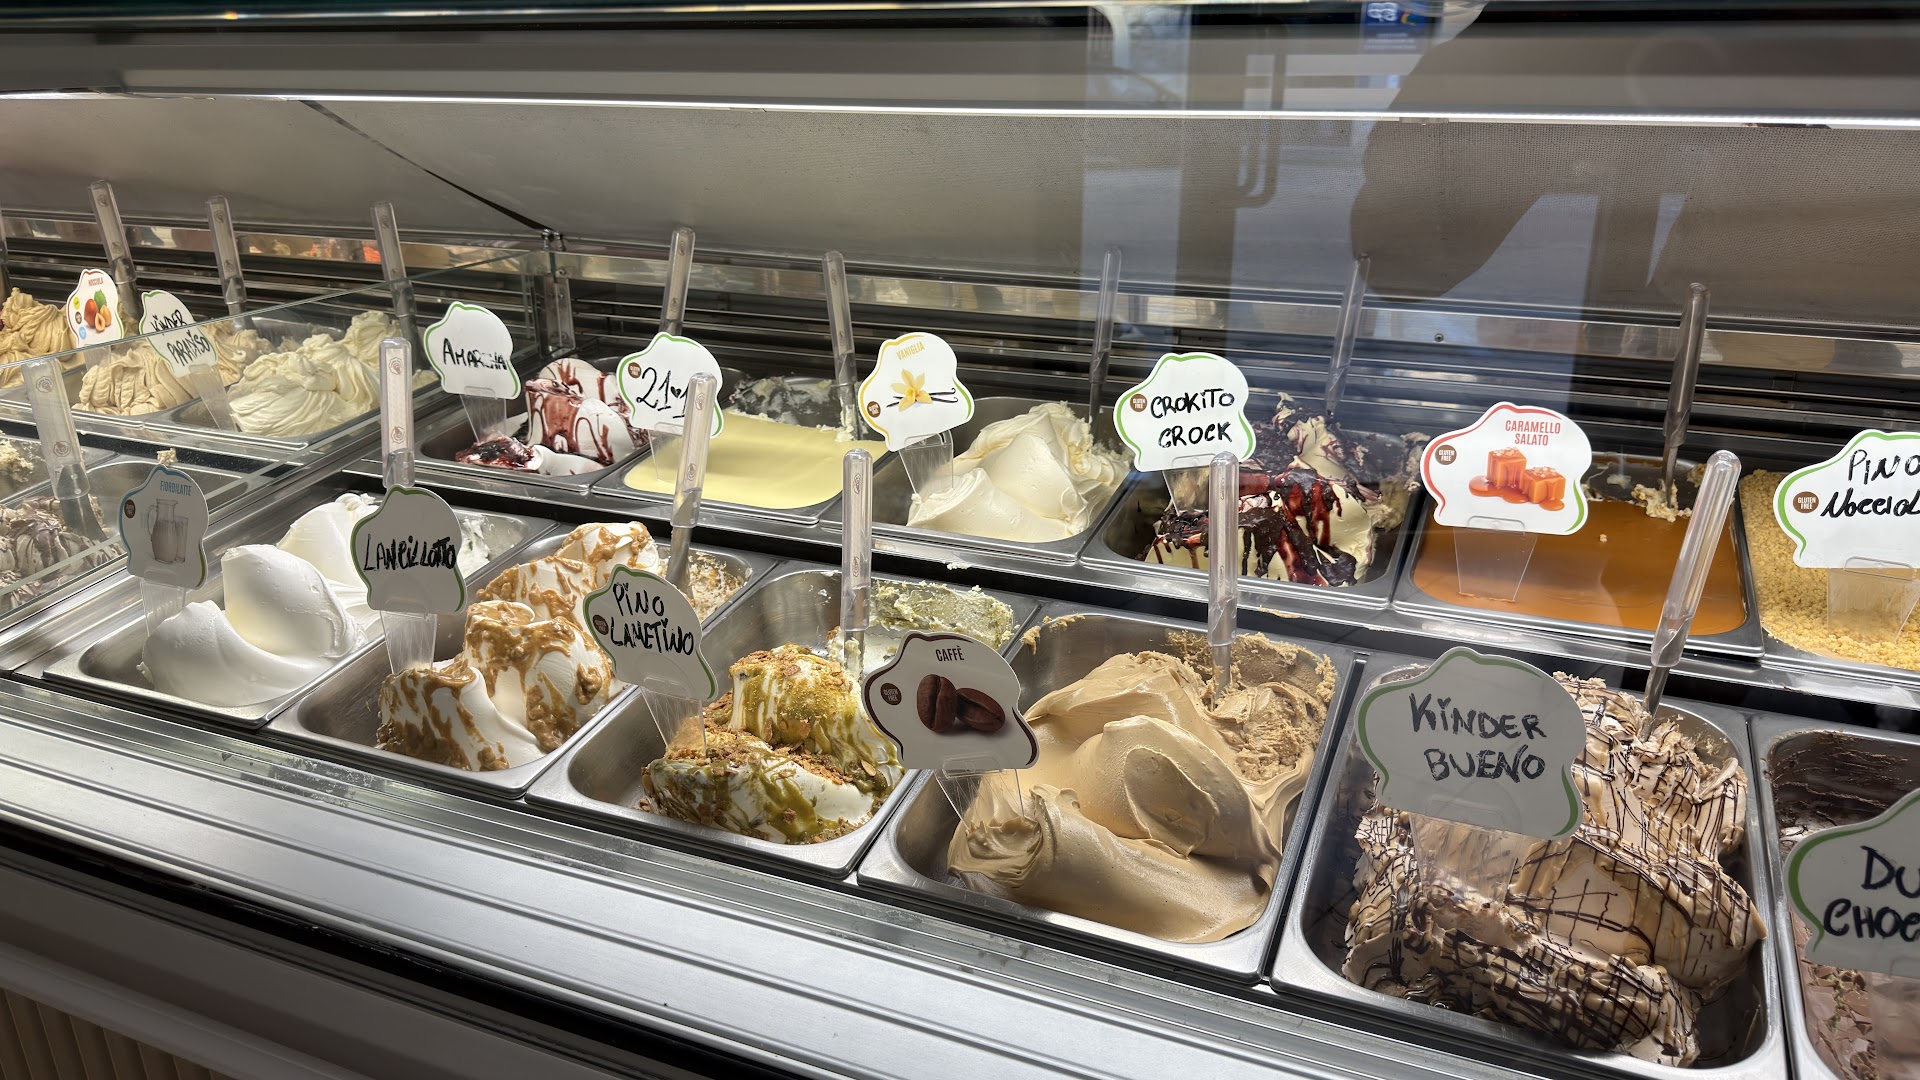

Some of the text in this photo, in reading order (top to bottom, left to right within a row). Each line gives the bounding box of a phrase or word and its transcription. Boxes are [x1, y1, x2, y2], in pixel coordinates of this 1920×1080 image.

[896, 341, 926, 360] VANIGLIA
[1505, 420, 1561, 434] CARAMELLO
[1514, 433, 1549, 447] SALATO
[160, 480, 192, 496] FIORDILATTE
[1797, 496, 1816, 504] GLUTEN
[1800, 502, 1813, 510] FREE
[935, 645, 965, 662] CAFFÈ
[1423, 743, 1546, 784] BUENO
